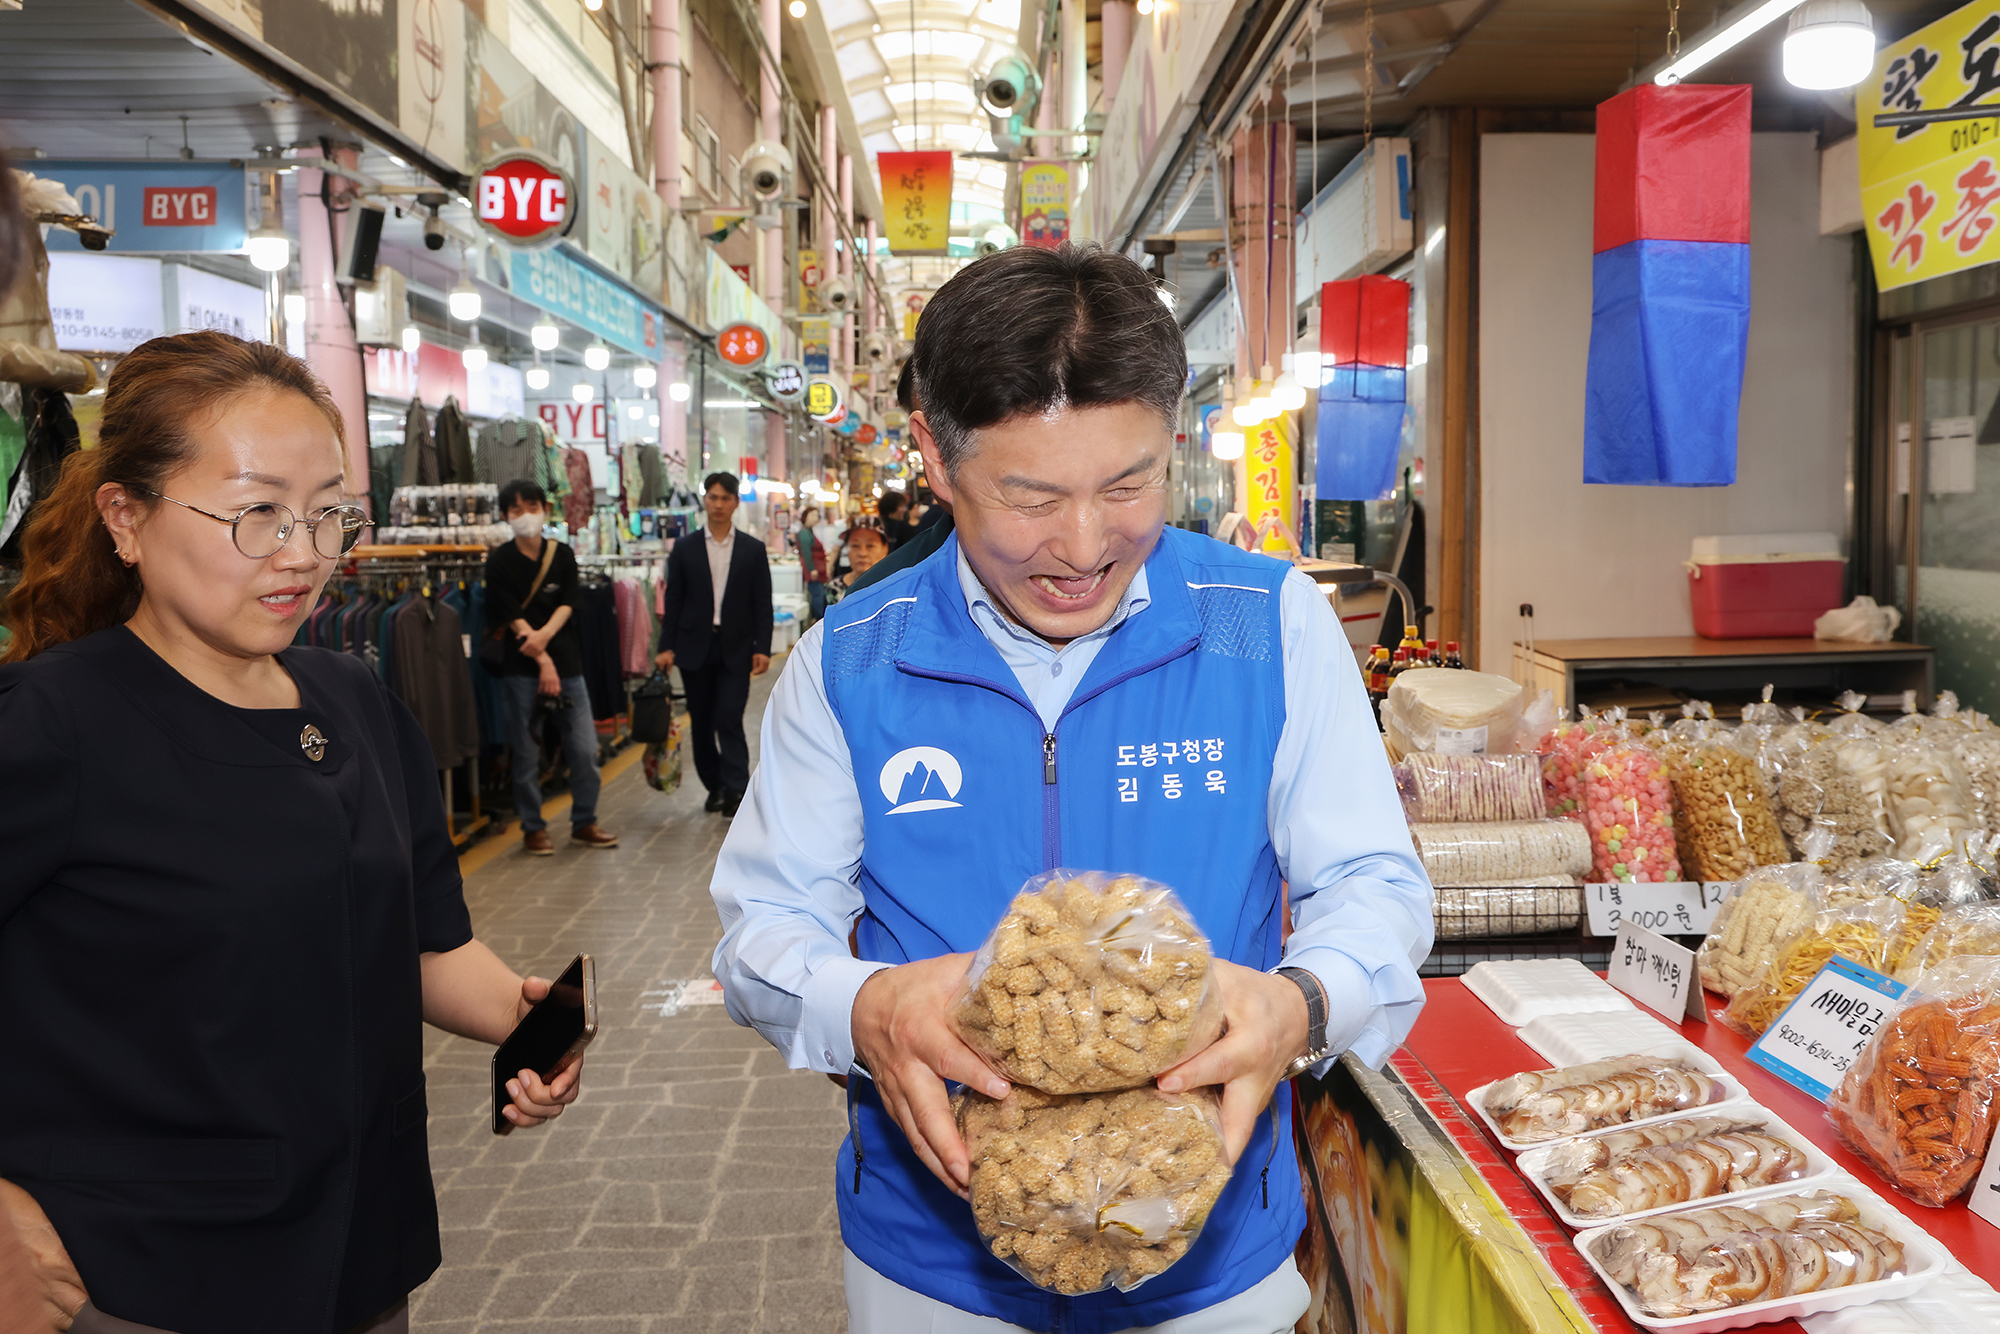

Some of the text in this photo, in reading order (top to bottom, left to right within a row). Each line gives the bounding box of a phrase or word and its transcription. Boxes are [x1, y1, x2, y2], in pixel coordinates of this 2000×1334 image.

[151, 193, 209, 219] BYC
[479, 175, 566, 222] BYC
[1116, 738, 1226, 768] 도봉구청장
[1810, 988, 1888, 1036] 새마을금
[1778, 1023, 1852, 1073] 9002-1624-25
